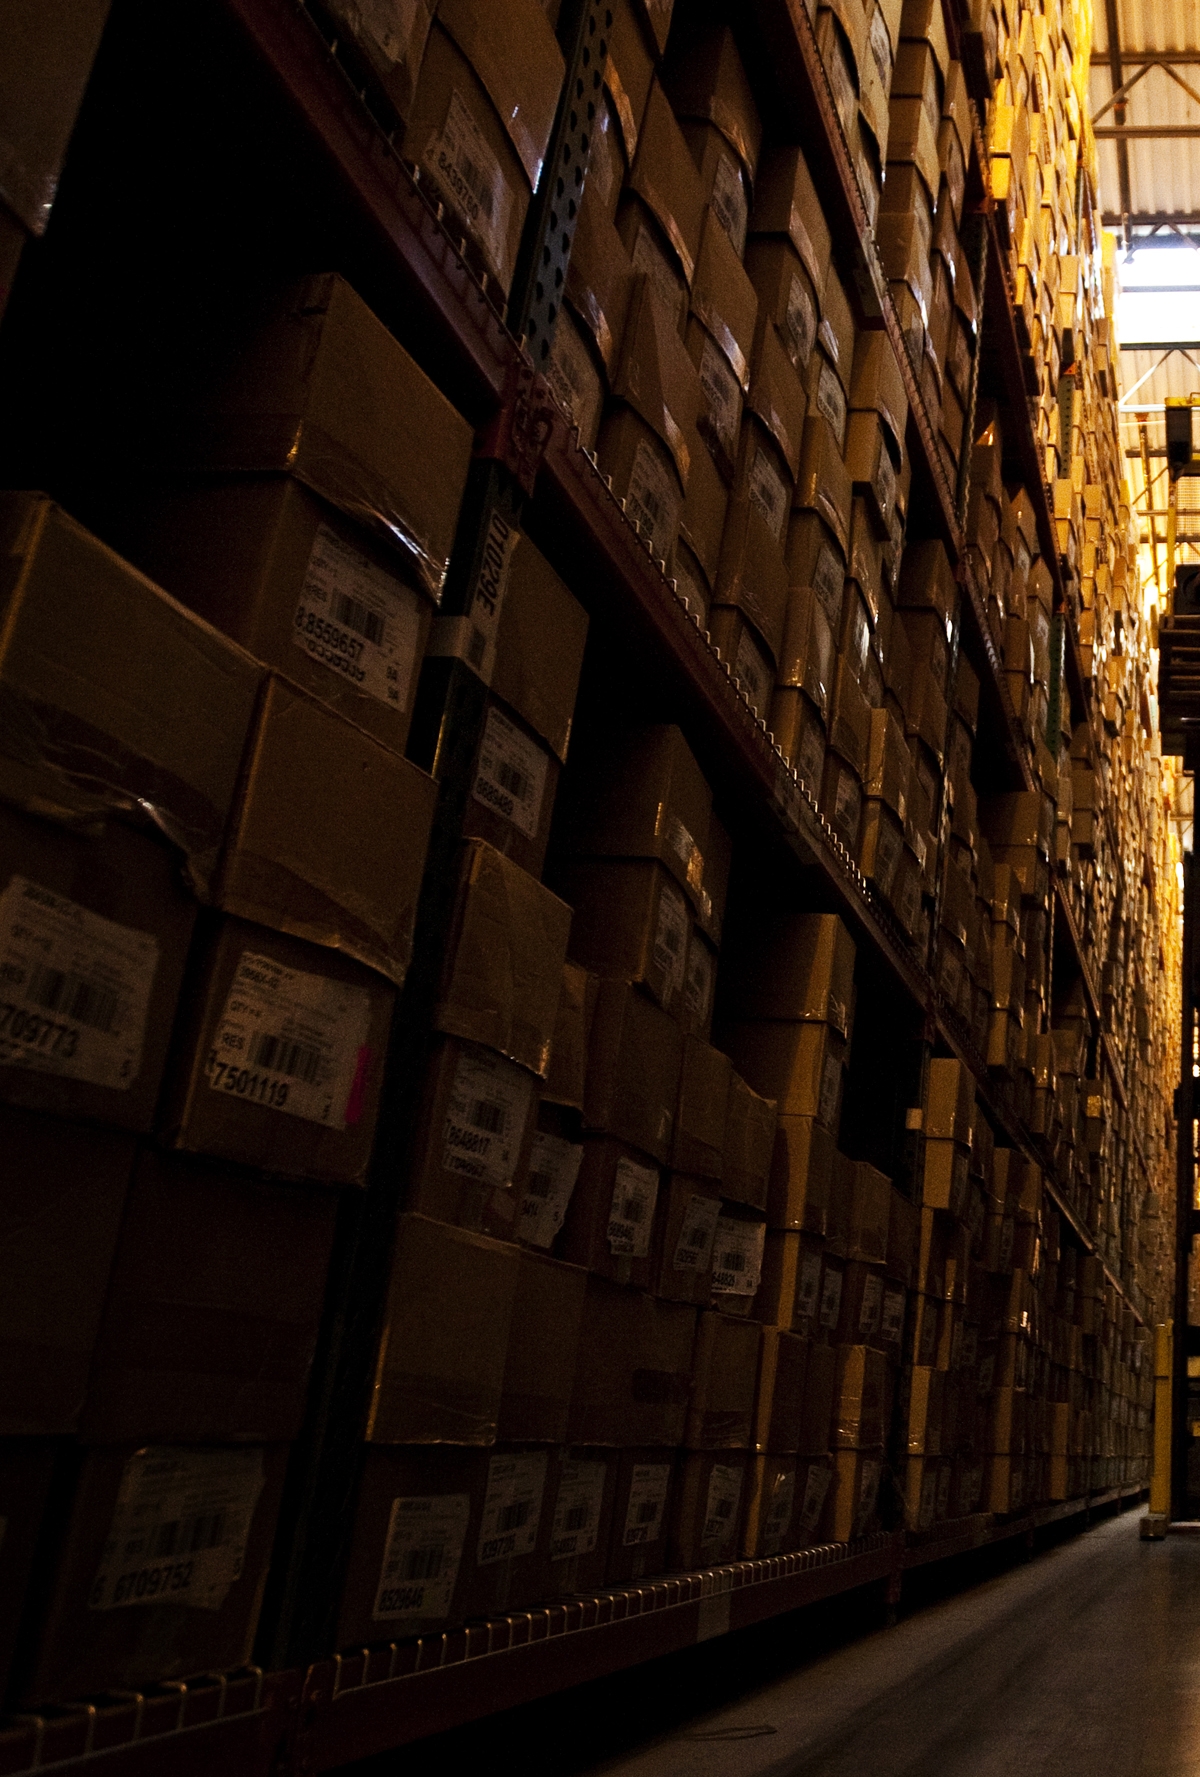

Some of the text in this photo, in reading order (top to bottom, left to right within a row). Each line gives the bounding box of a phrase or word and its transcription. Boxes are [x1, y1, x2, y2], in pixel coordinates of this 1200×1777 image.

[476, 513, 509, 617] 01029E
[306, 613, 365, 660] 8559657
[223, 1032, 246, 1051] RES
[214, 1061, 290, 1108] 7501119
[113, 1560, 194, 1603] 6709752
